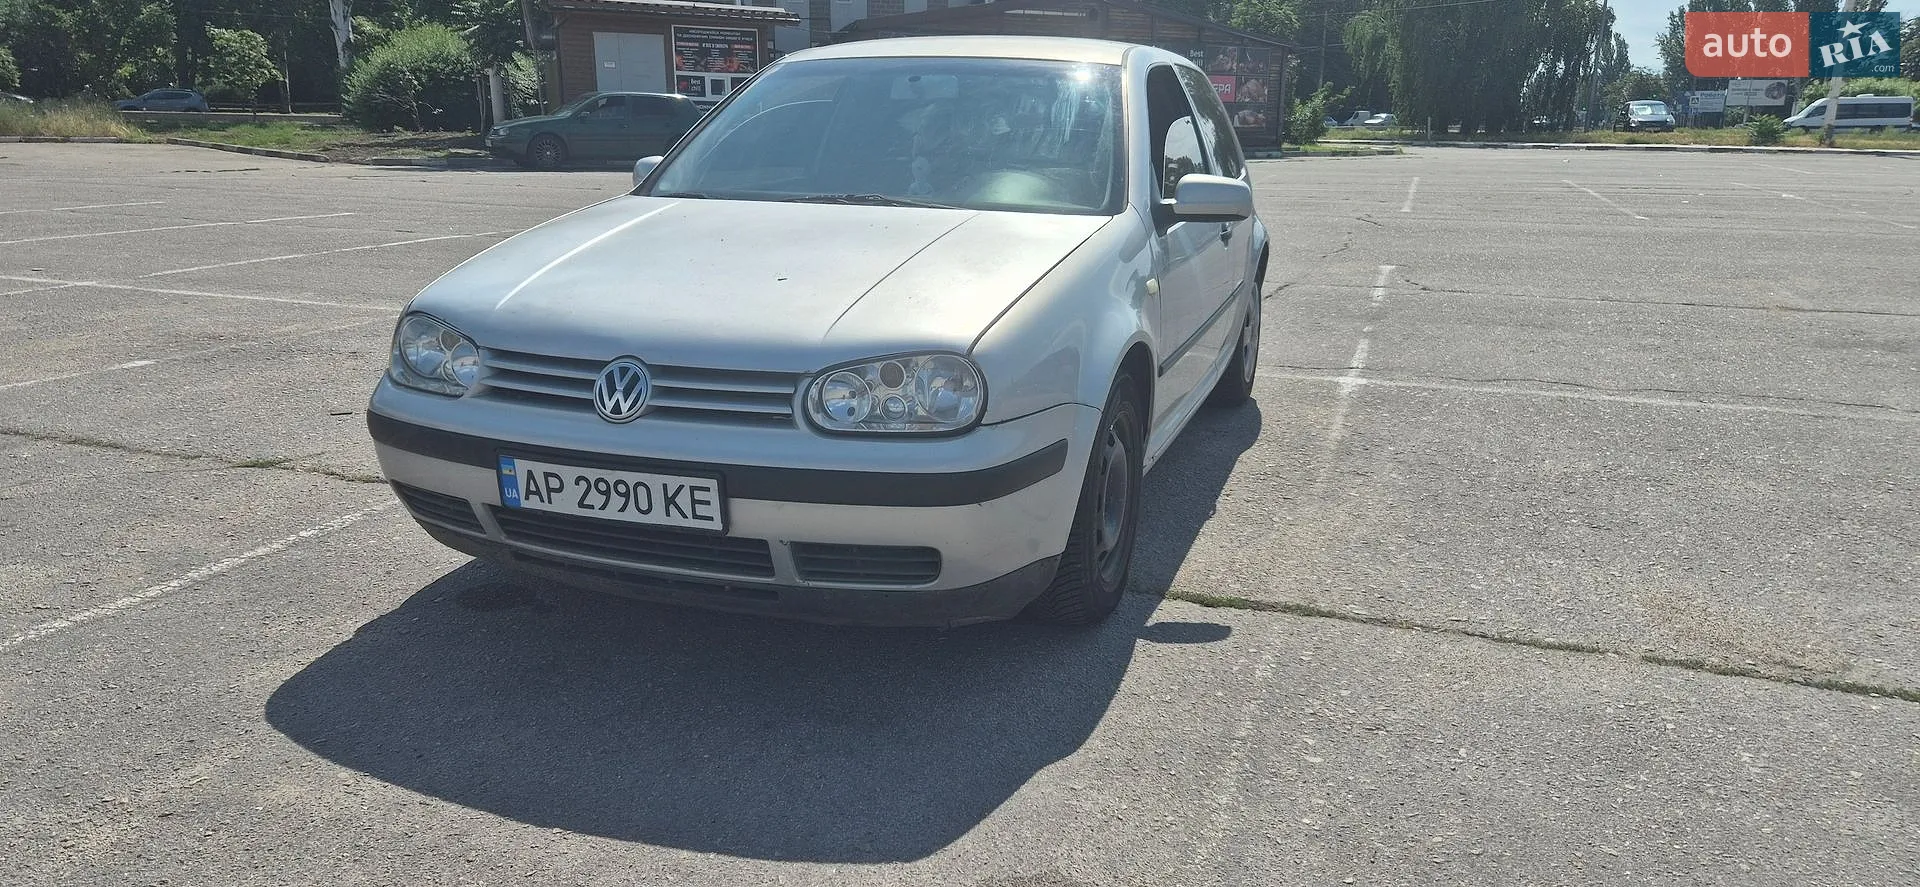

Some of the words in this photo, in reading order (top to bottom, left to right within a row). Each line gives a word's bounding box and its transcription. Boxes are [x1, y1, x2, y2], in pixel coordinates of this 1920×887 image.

[505, 488, 519, 500] UA
[524, 469, 565, 504] AP
[574, 475, 653, 515] 2990
[663, 483, 714, 521] KE
